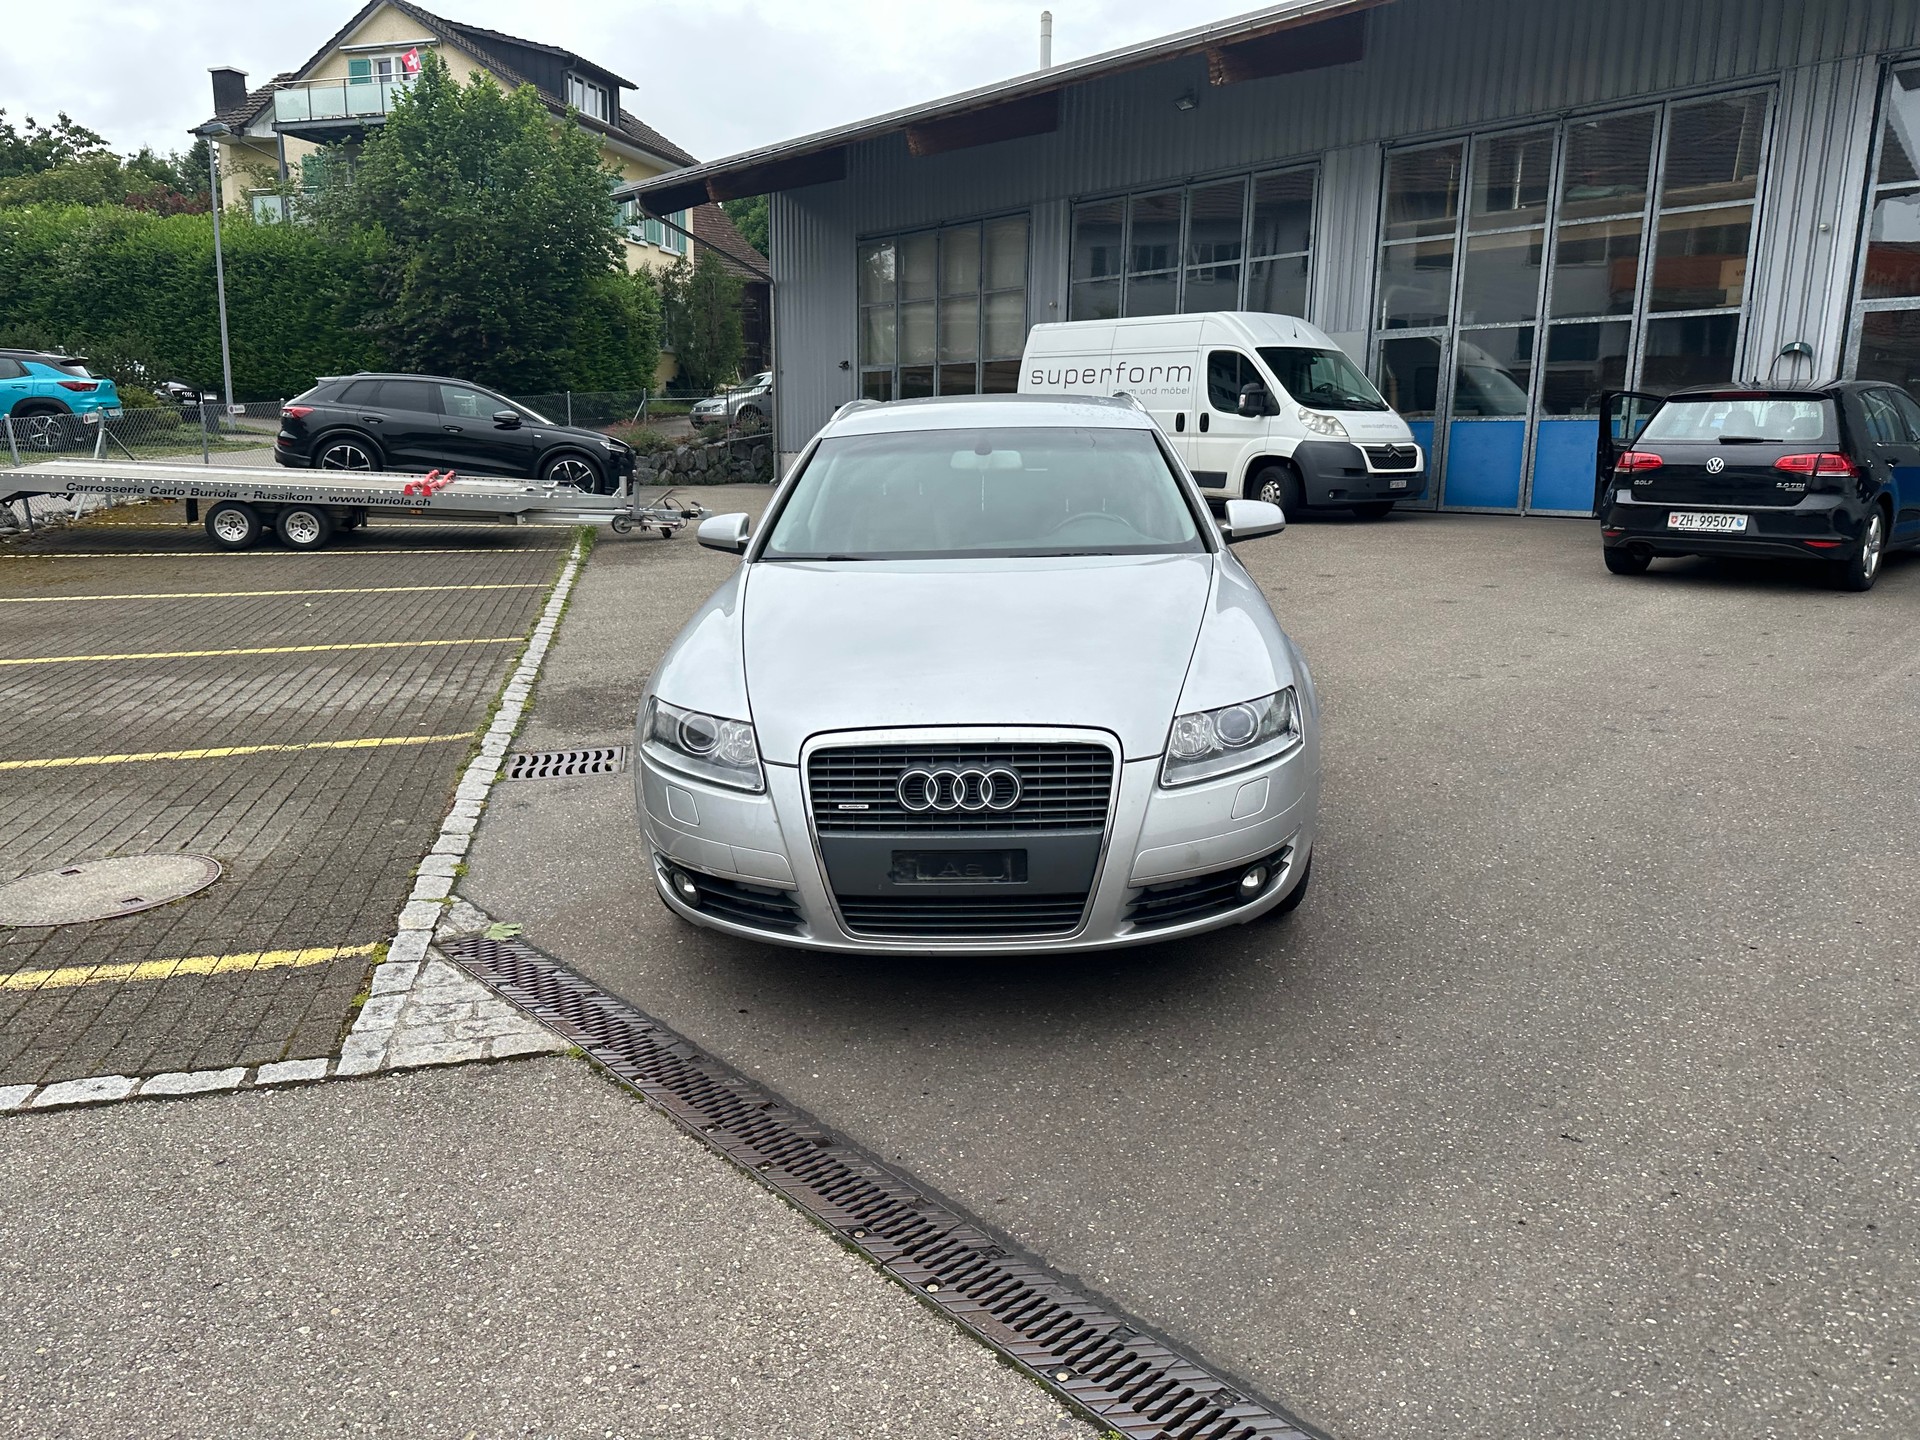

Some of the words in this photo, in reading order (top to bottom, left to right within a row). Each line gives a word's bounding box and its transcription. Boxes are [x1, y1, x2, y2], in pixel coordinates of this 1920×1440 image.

[1031, 361, 1192, 389] superform
[1140, 387, 1158, 395] und
[66, 482, 145, 495] Carrosserie
[149, 485, 186, 496] Carlo
[190, 487, 238, 498] Buriola
[253, 490, 313, 502] Russikon
[328, 494, 431, 507] www.buriola.ch
